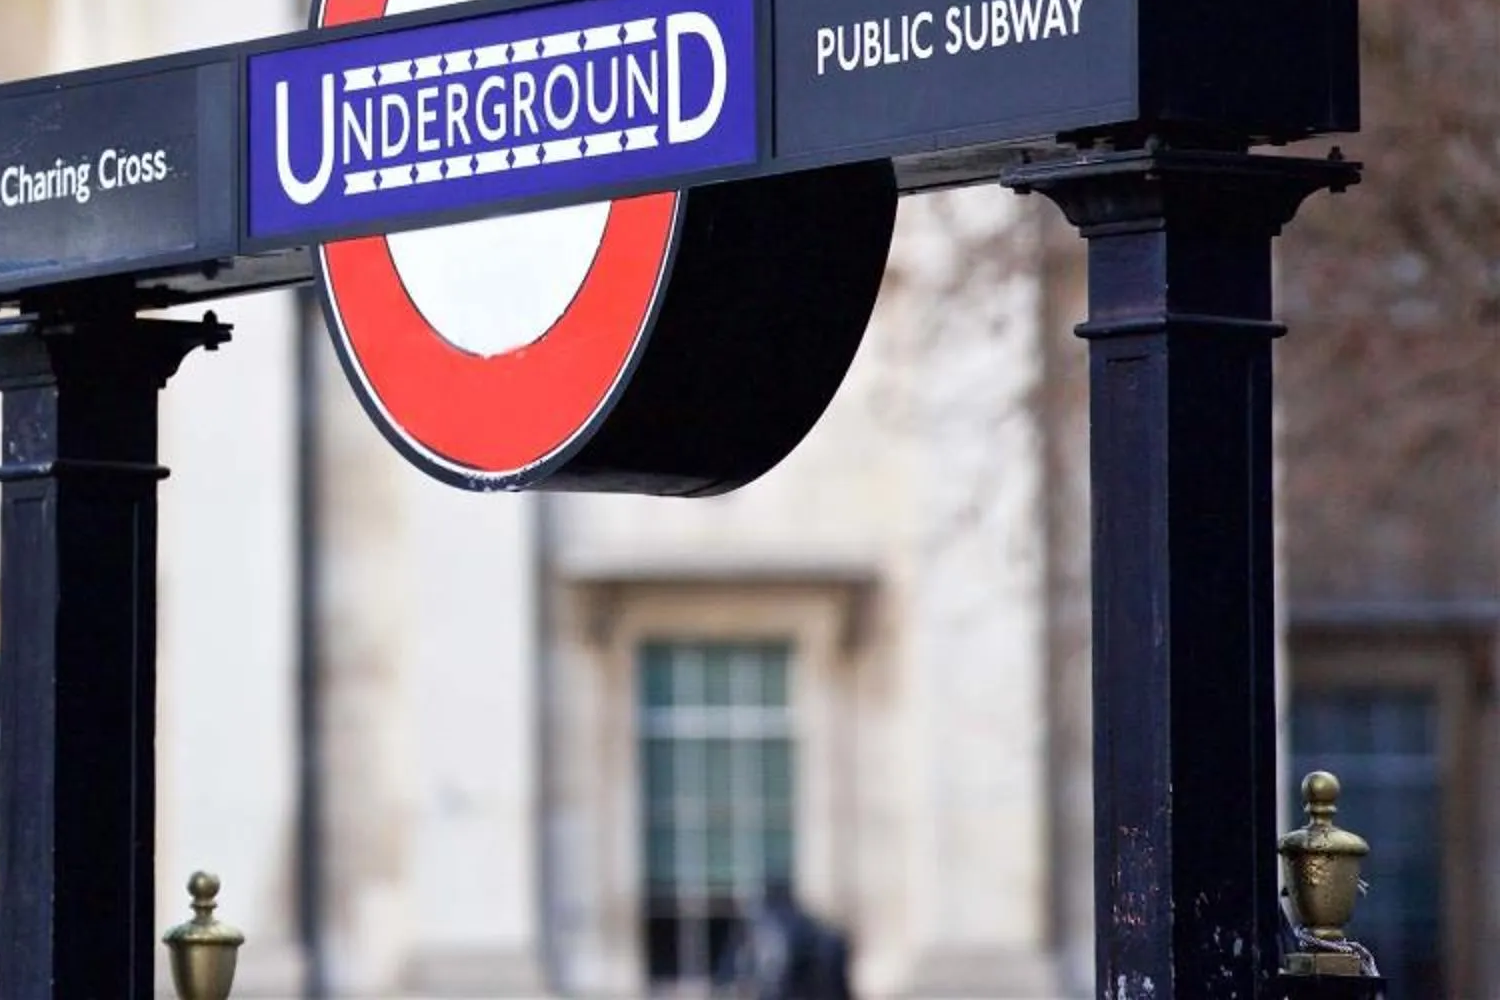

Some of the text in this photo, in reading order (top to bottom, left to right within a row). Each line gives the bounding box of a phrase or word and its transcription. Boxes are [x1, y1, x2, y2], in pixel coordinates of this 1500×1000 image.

[816, 11, 934, 76] PUBLIC
[275, 11, 728, 205] UNDERGROUND
[0, 148, 168, 208] Charing Cross
